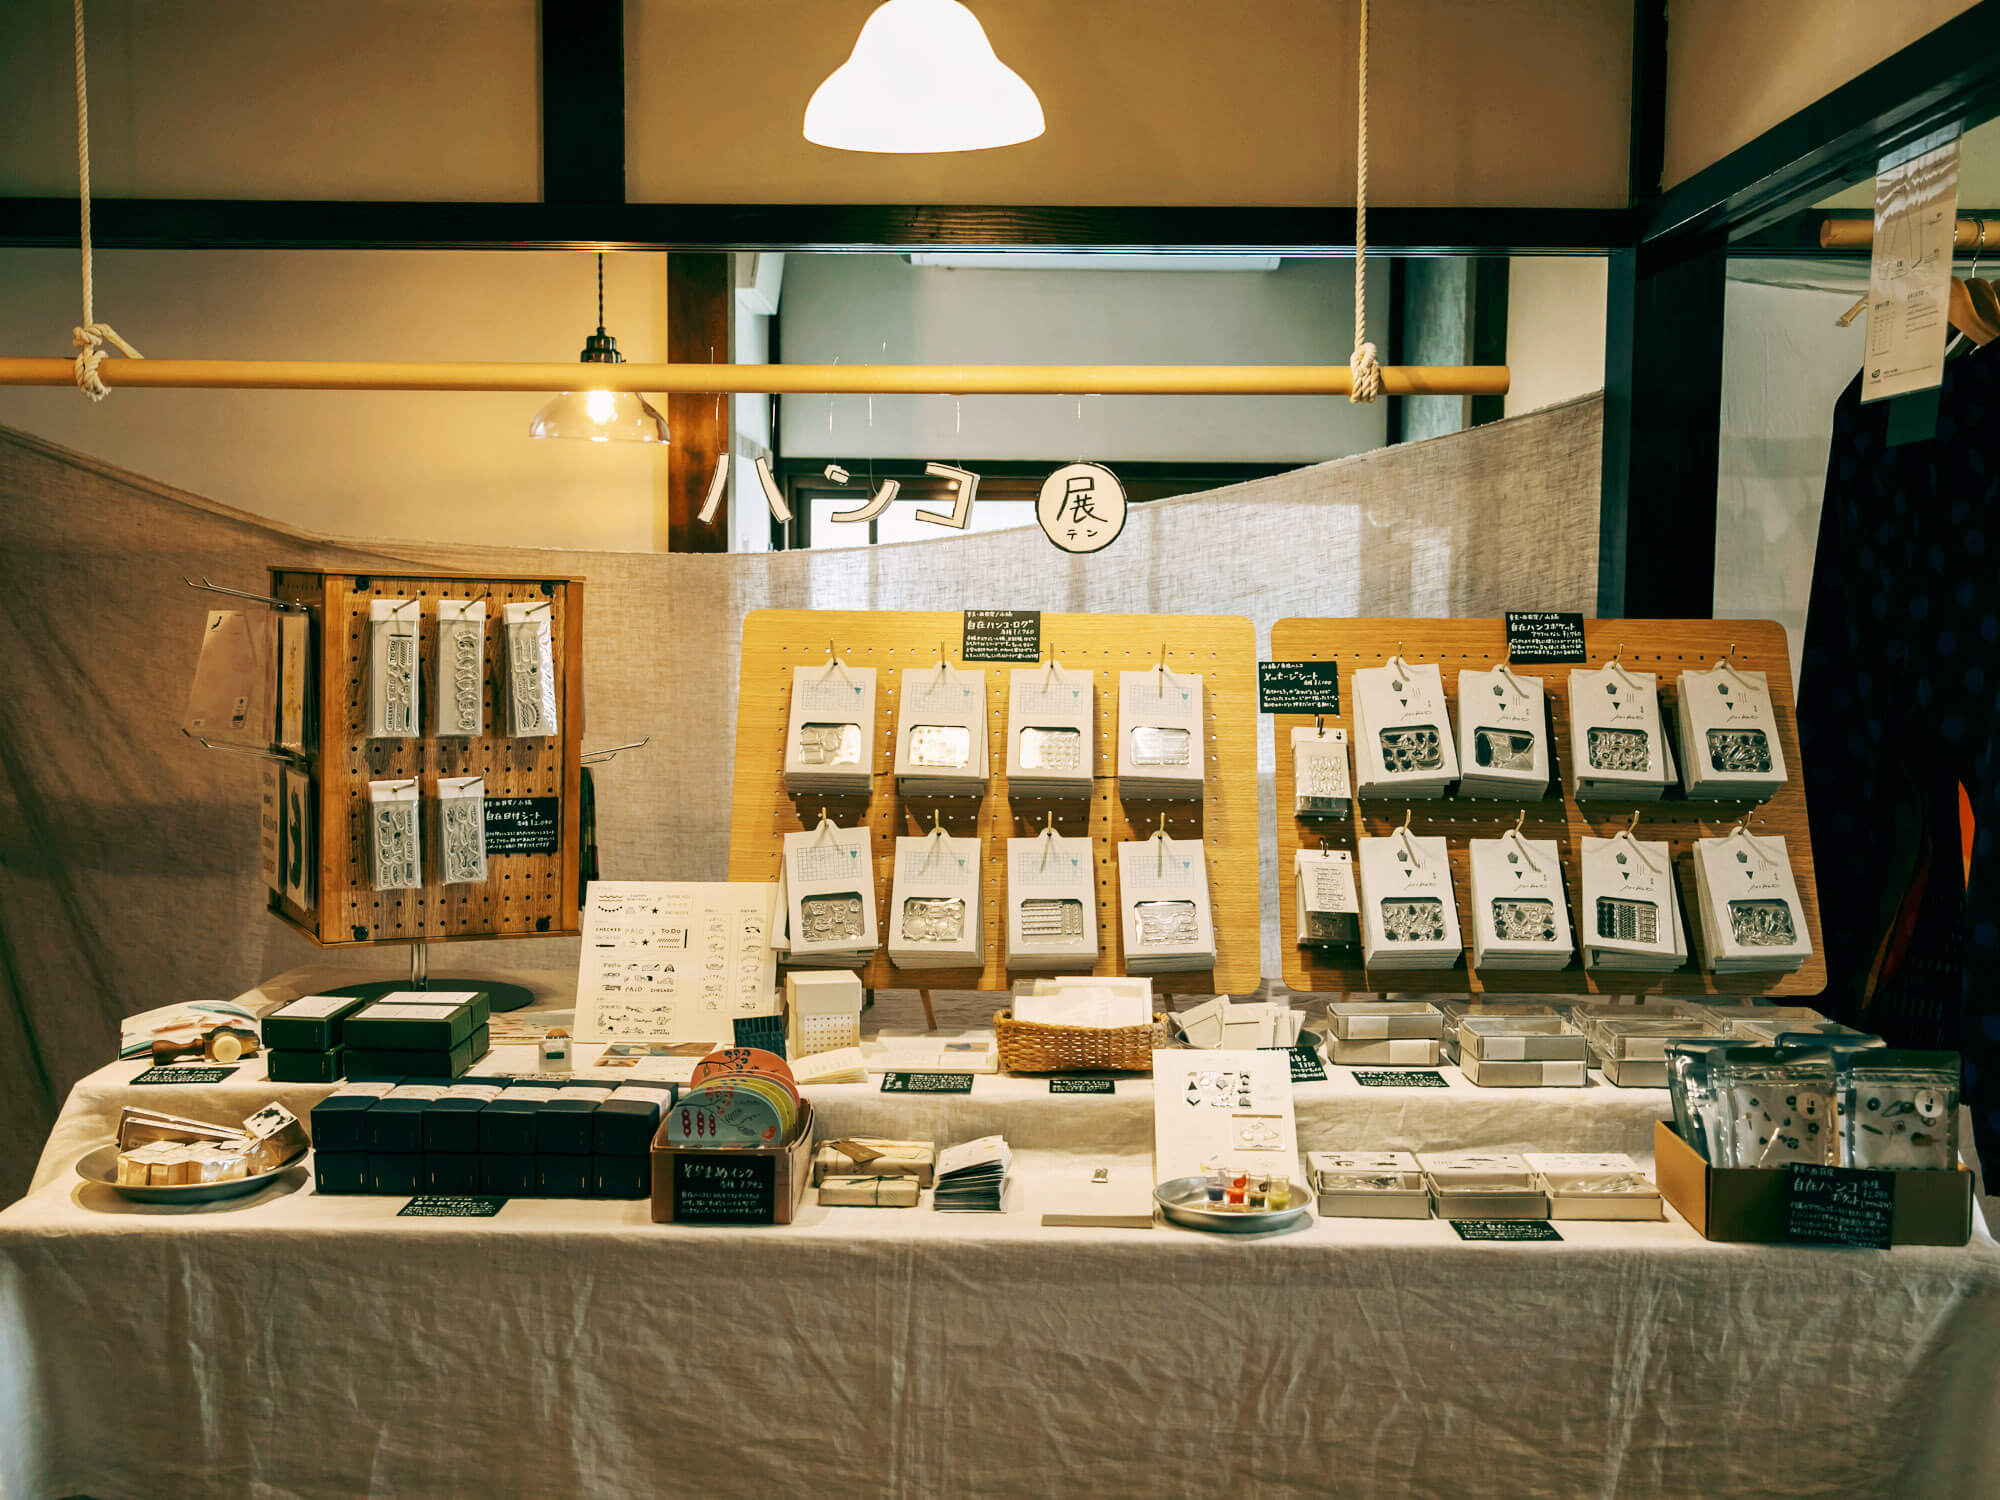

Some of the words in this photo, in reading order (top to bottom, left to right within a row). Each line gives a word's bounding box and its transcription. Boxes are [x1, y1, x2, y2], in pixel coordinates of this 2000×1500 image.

[698, 453, 981, 529] ハンコ
[1057, 477, 1108, 523] 展
[1065, 528, 1098, 541] テン
